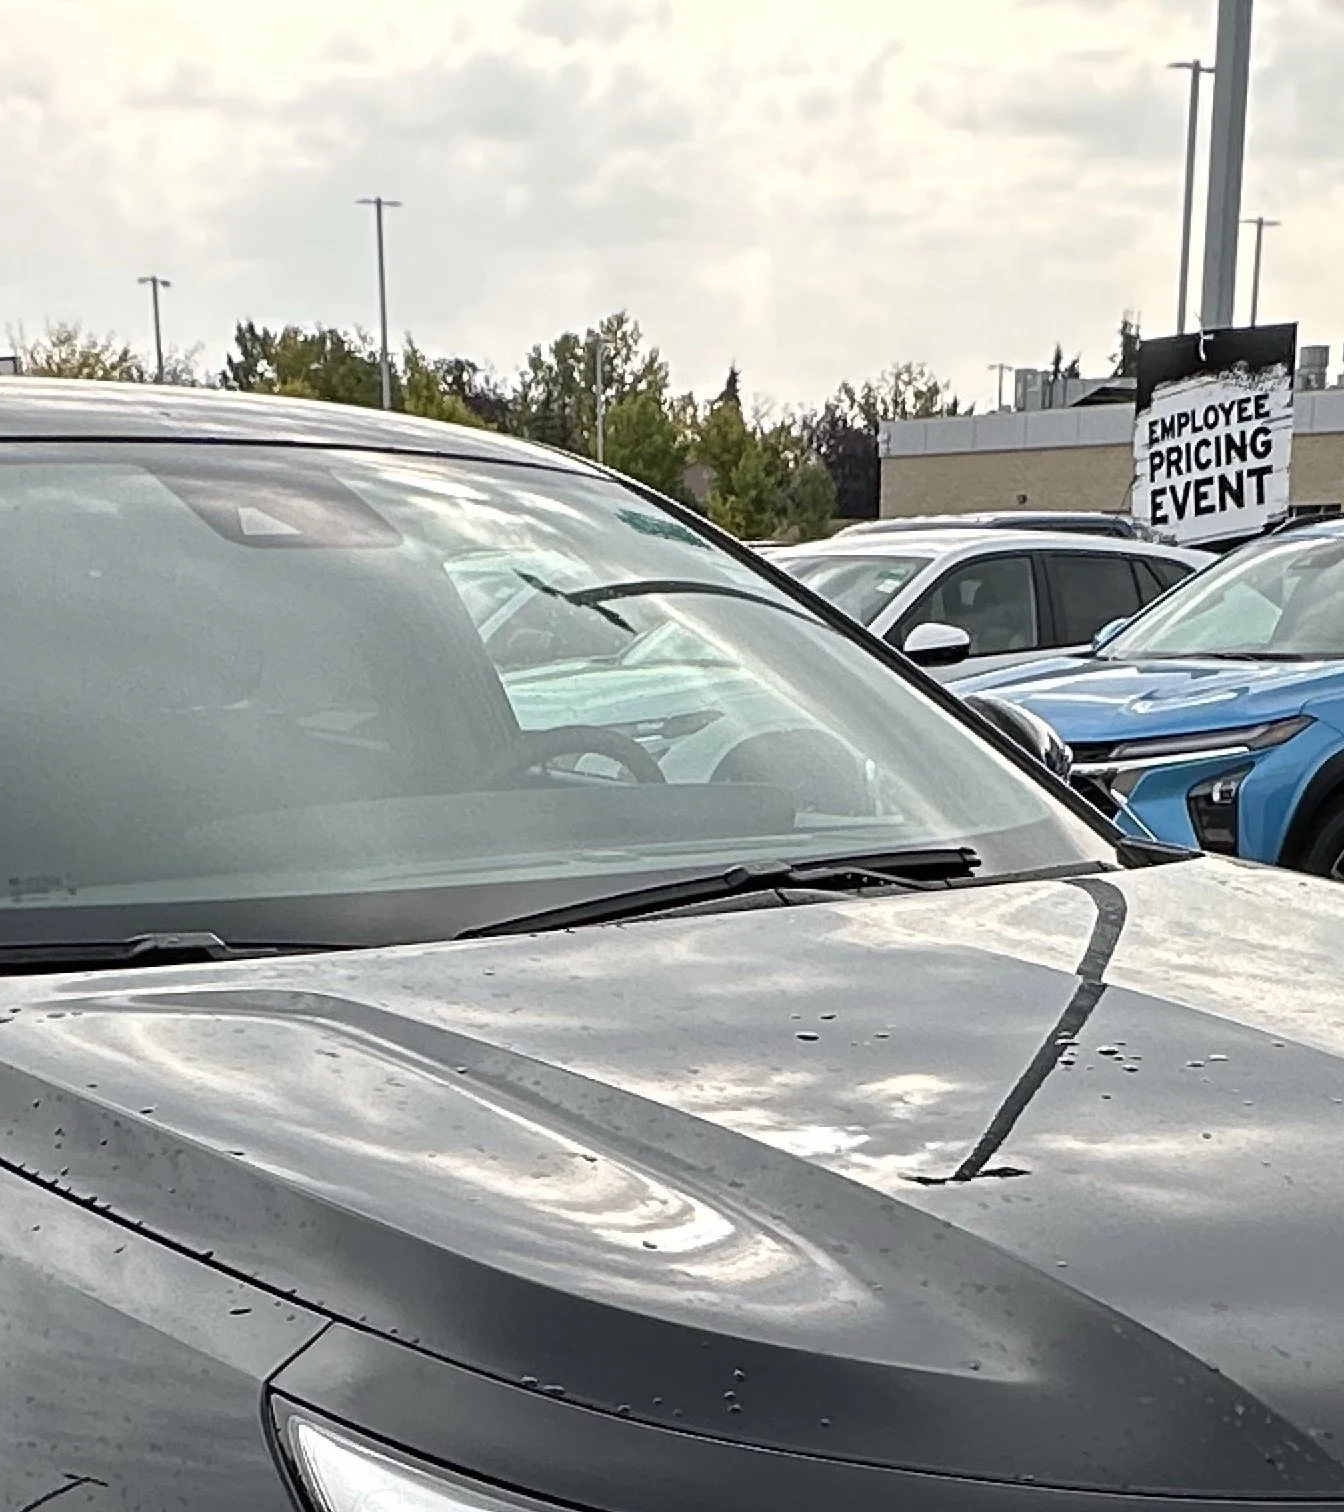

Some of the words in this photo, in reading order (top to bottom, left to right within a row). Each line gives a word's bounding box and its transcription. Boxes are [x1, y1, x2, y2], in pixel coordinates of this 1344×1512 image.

[1148, 394, 1271, 446] EMPLOYEE
[1149, 426, 1272, 483] PRICING
[1150, 465, 1274, 526] EVENT
